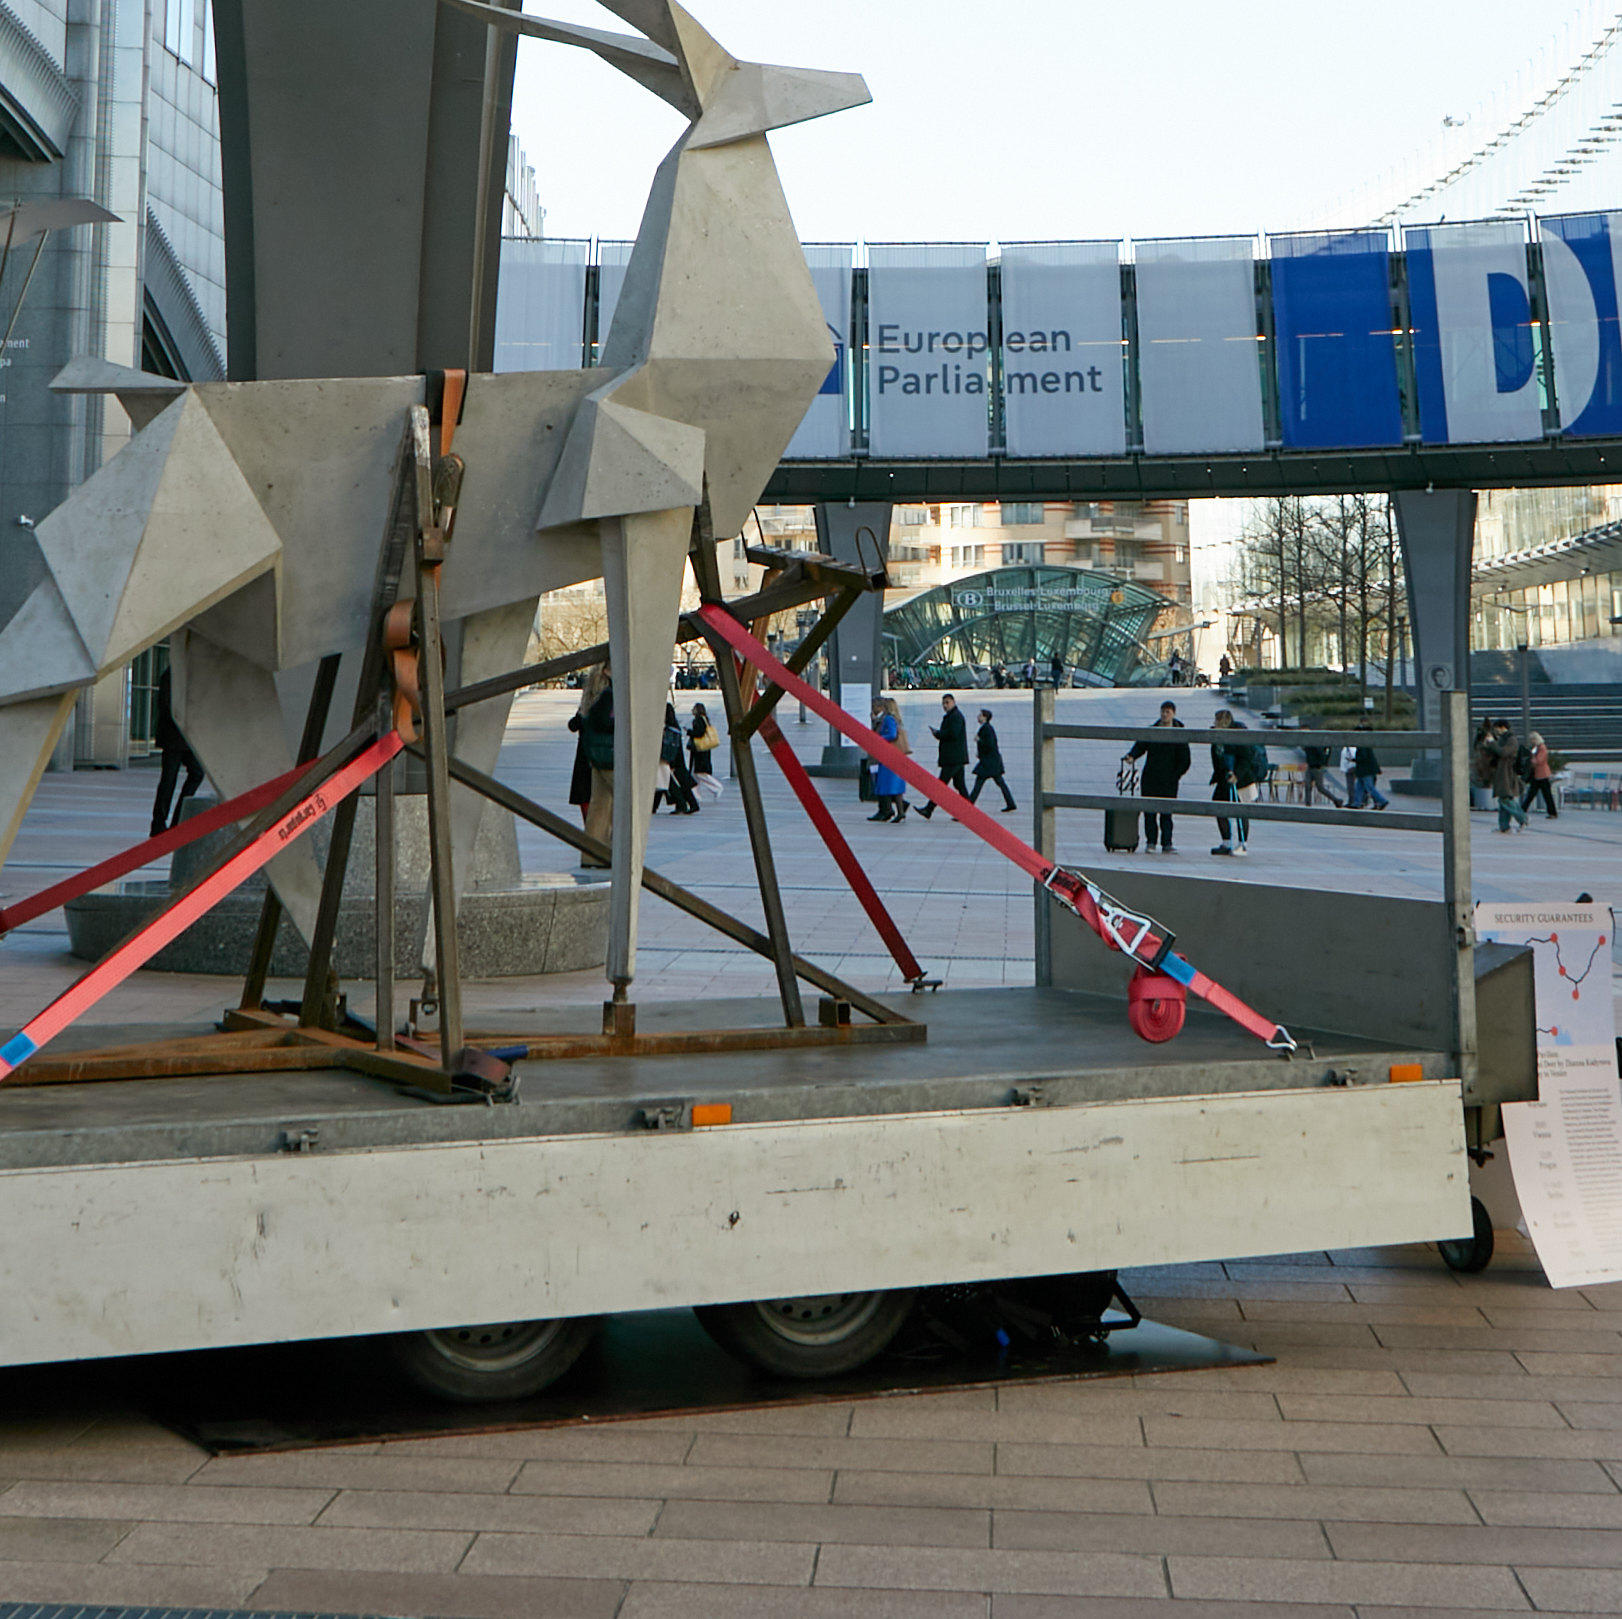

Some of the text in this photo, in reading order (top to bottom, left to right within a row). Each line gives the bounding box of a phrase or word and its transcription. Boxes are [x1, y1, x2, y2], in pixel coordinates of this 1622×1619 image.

[878, 324, 1071, 359] European
[878, 364, 1103, 395] Parliament
[1494, 913, 1594, 924] SECURITY GUARANTEES
